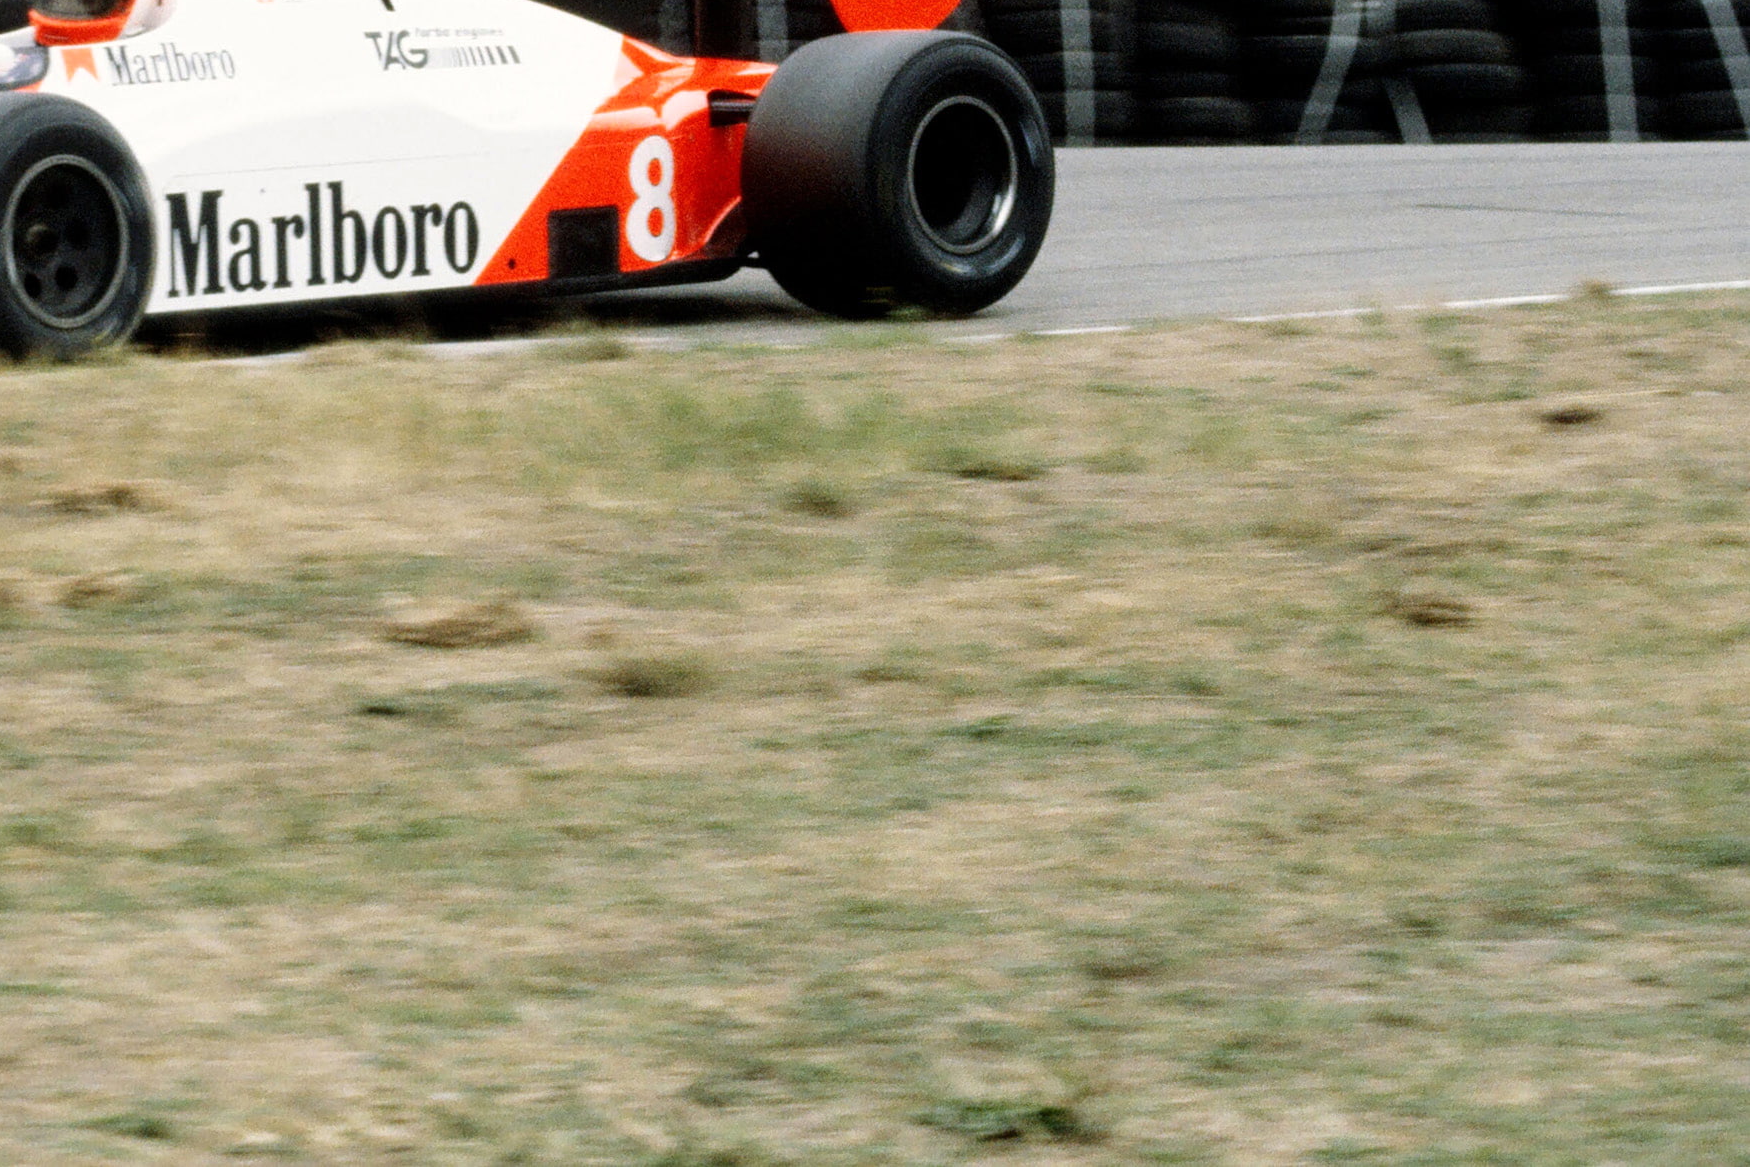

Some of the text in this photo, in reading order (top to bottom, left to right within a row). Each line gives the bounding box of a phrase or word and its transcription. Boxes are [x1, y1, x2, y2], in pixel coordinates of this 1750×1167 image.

[104, 42, 236, 87] Marlboro
[363, 30, 428, 71] TAG
[625, 134, 677, 262] 8
[166, 181, 479, 299] Marlboro
